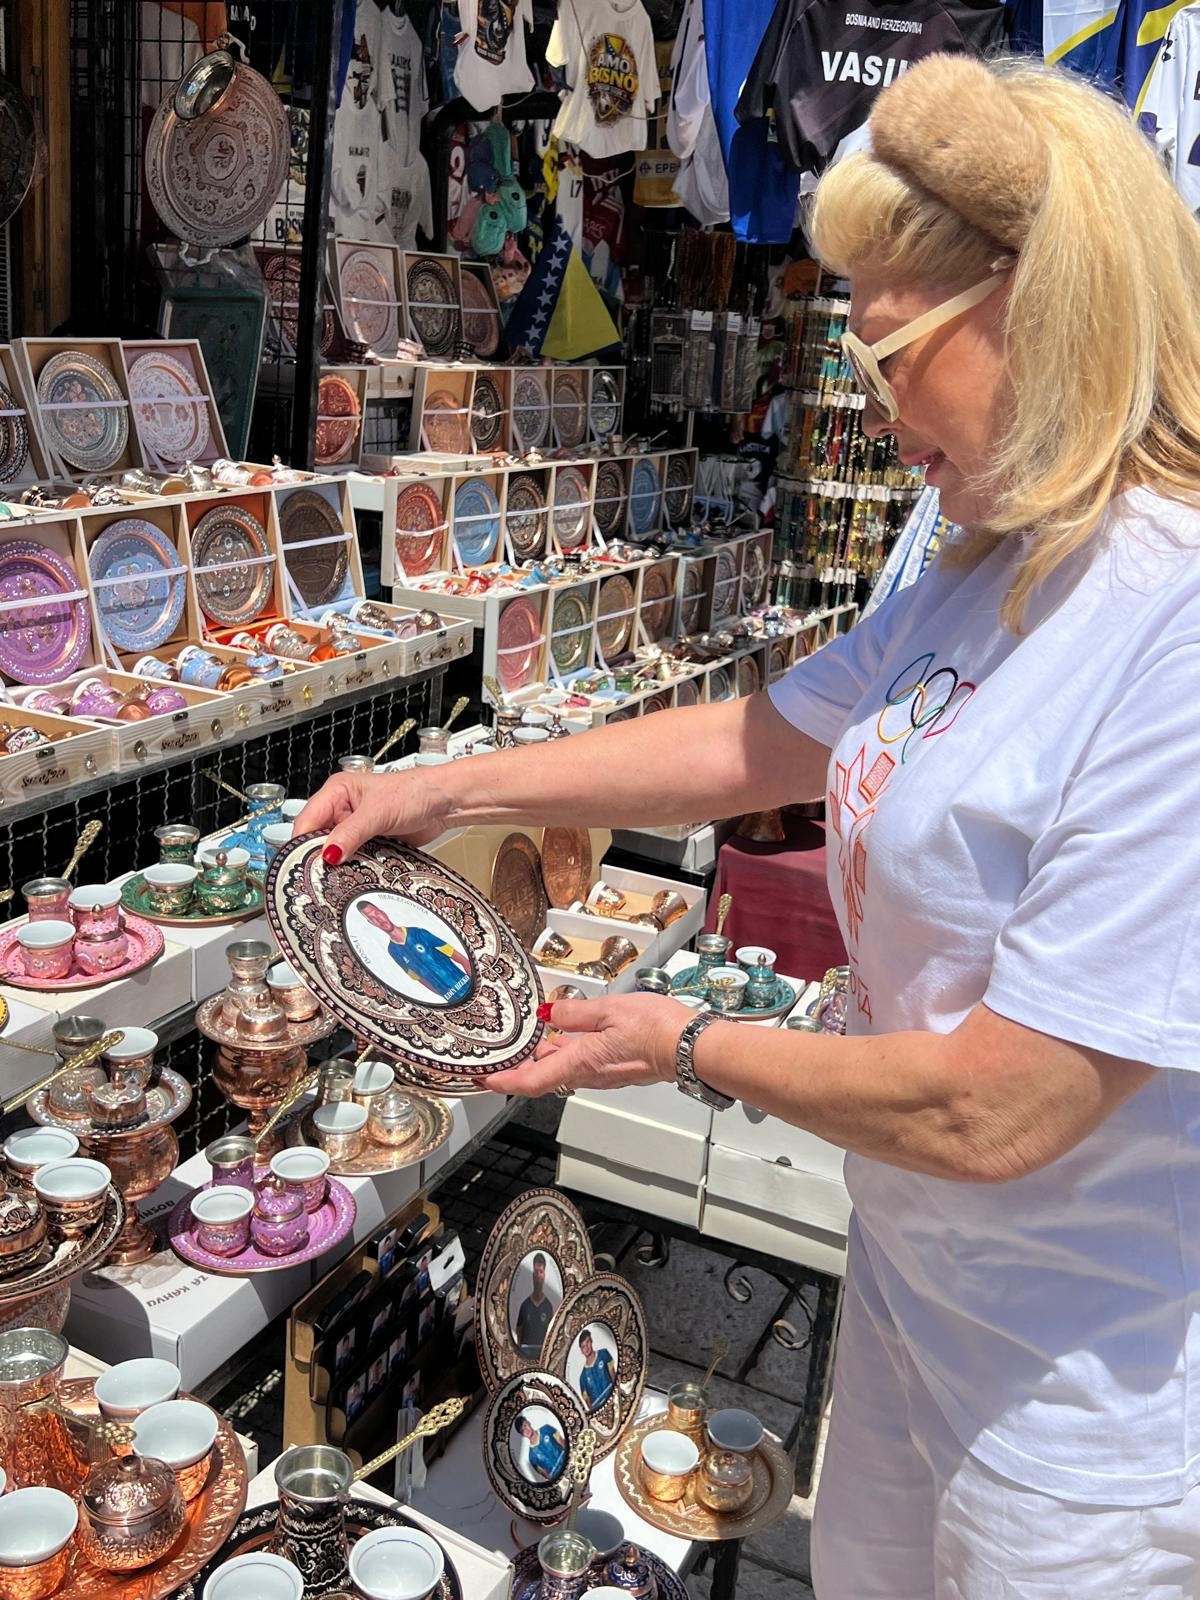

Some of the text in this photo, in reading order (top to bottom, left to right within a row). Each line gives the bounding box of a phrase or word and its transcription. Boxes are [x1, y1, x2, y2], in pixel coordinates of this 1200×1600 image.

[845, 13, 923, 35] BOSNIA AND HERZEGOVINA
[569, 179, 583, 198] 17
